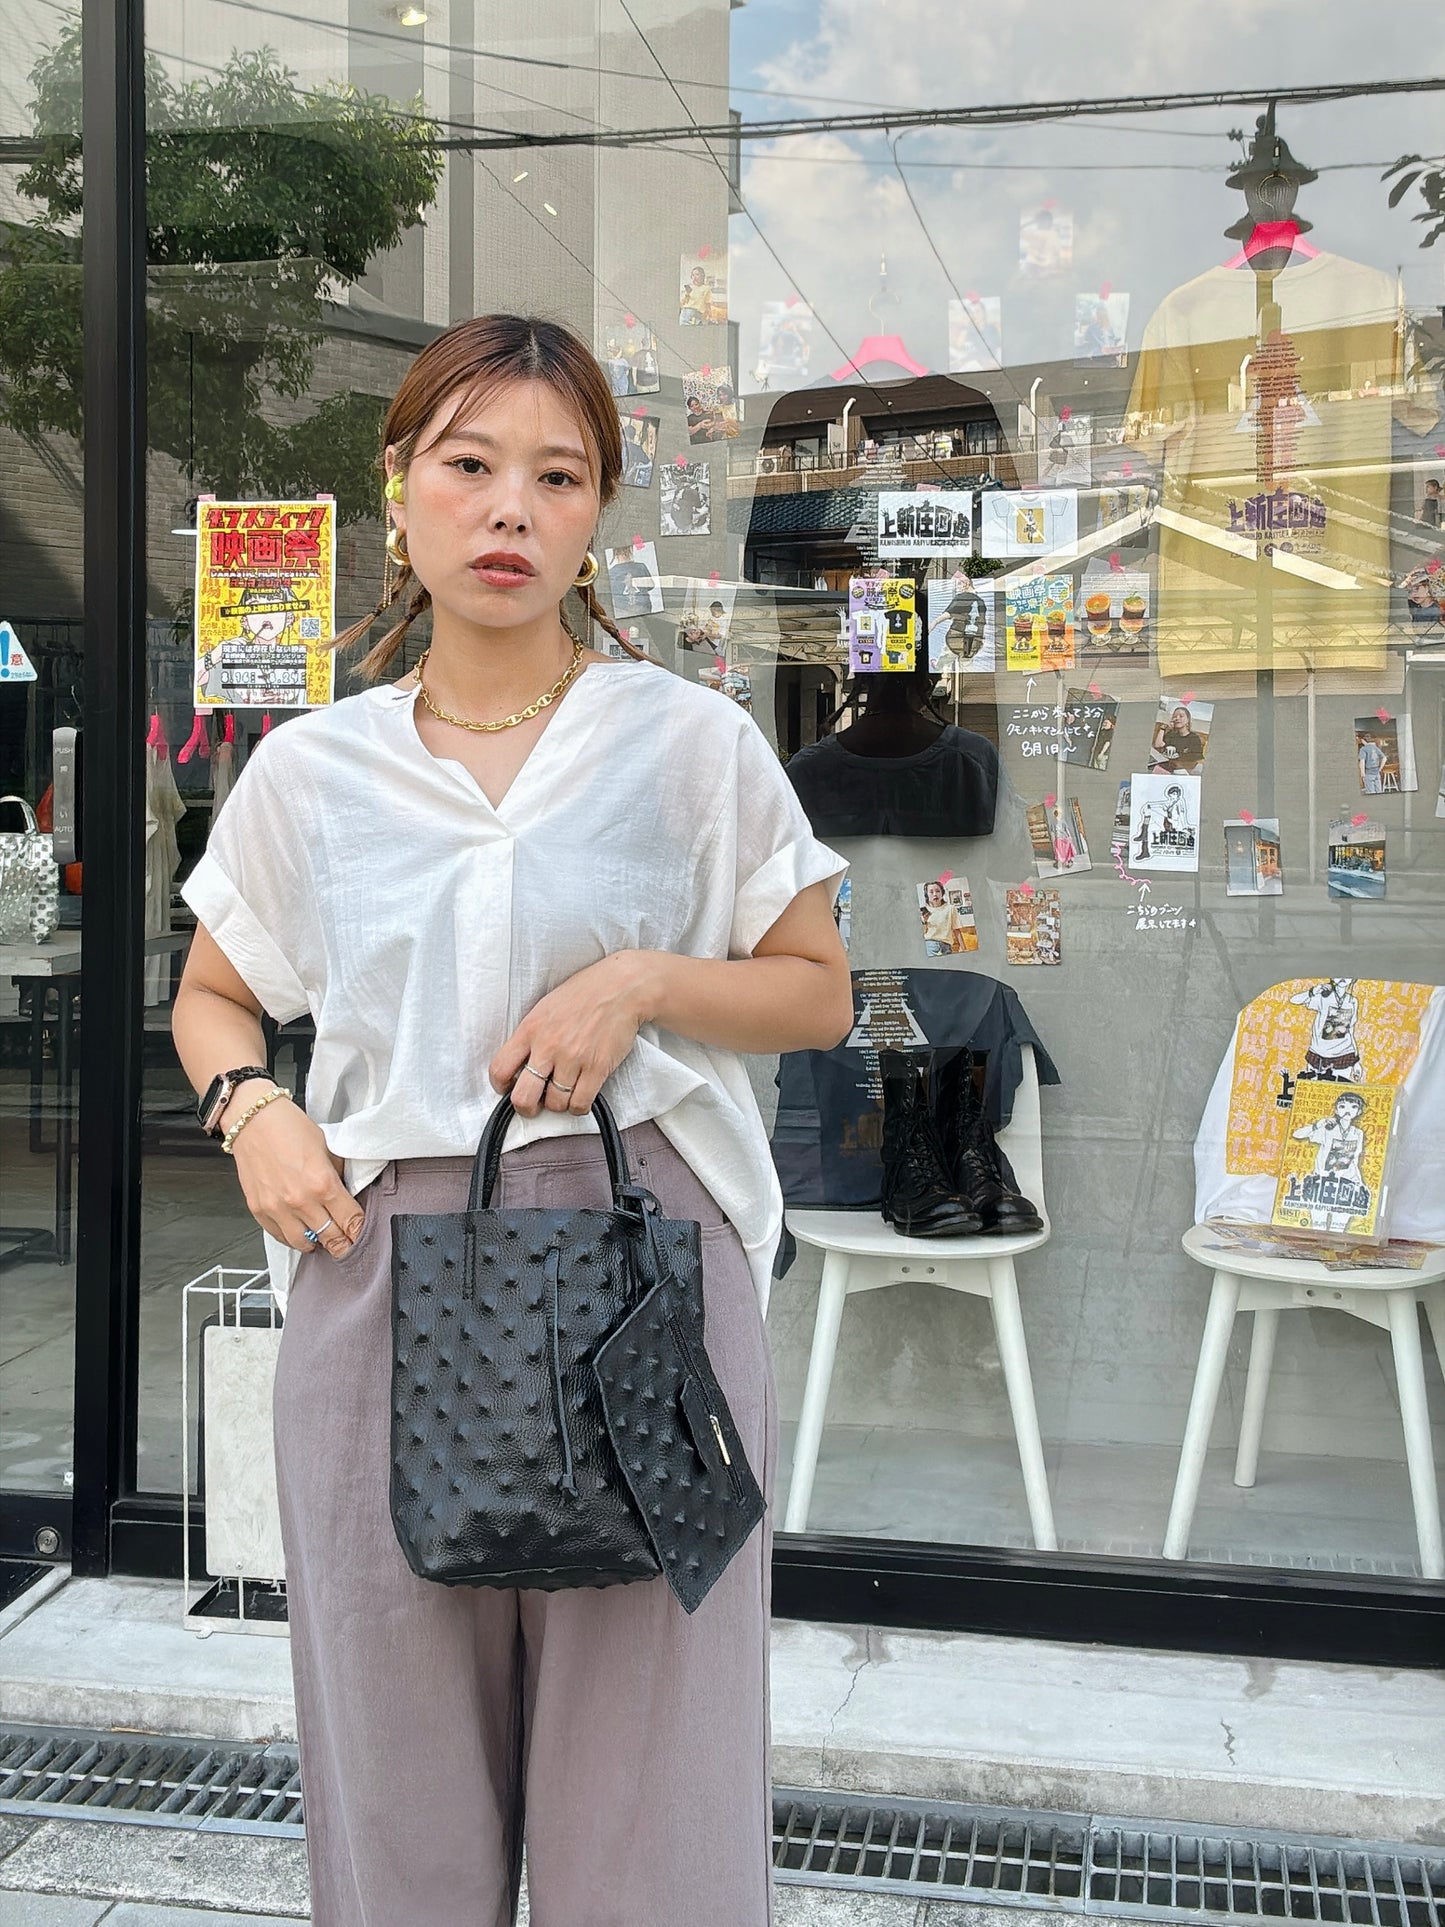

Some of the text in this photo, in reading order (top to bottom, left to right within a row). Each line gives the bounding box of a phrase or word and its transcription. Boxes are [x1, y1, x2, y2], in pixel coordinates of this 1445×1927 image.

[211, 530, 321, 568] 映画祭
[55, 825, 73, 833] AUTO
